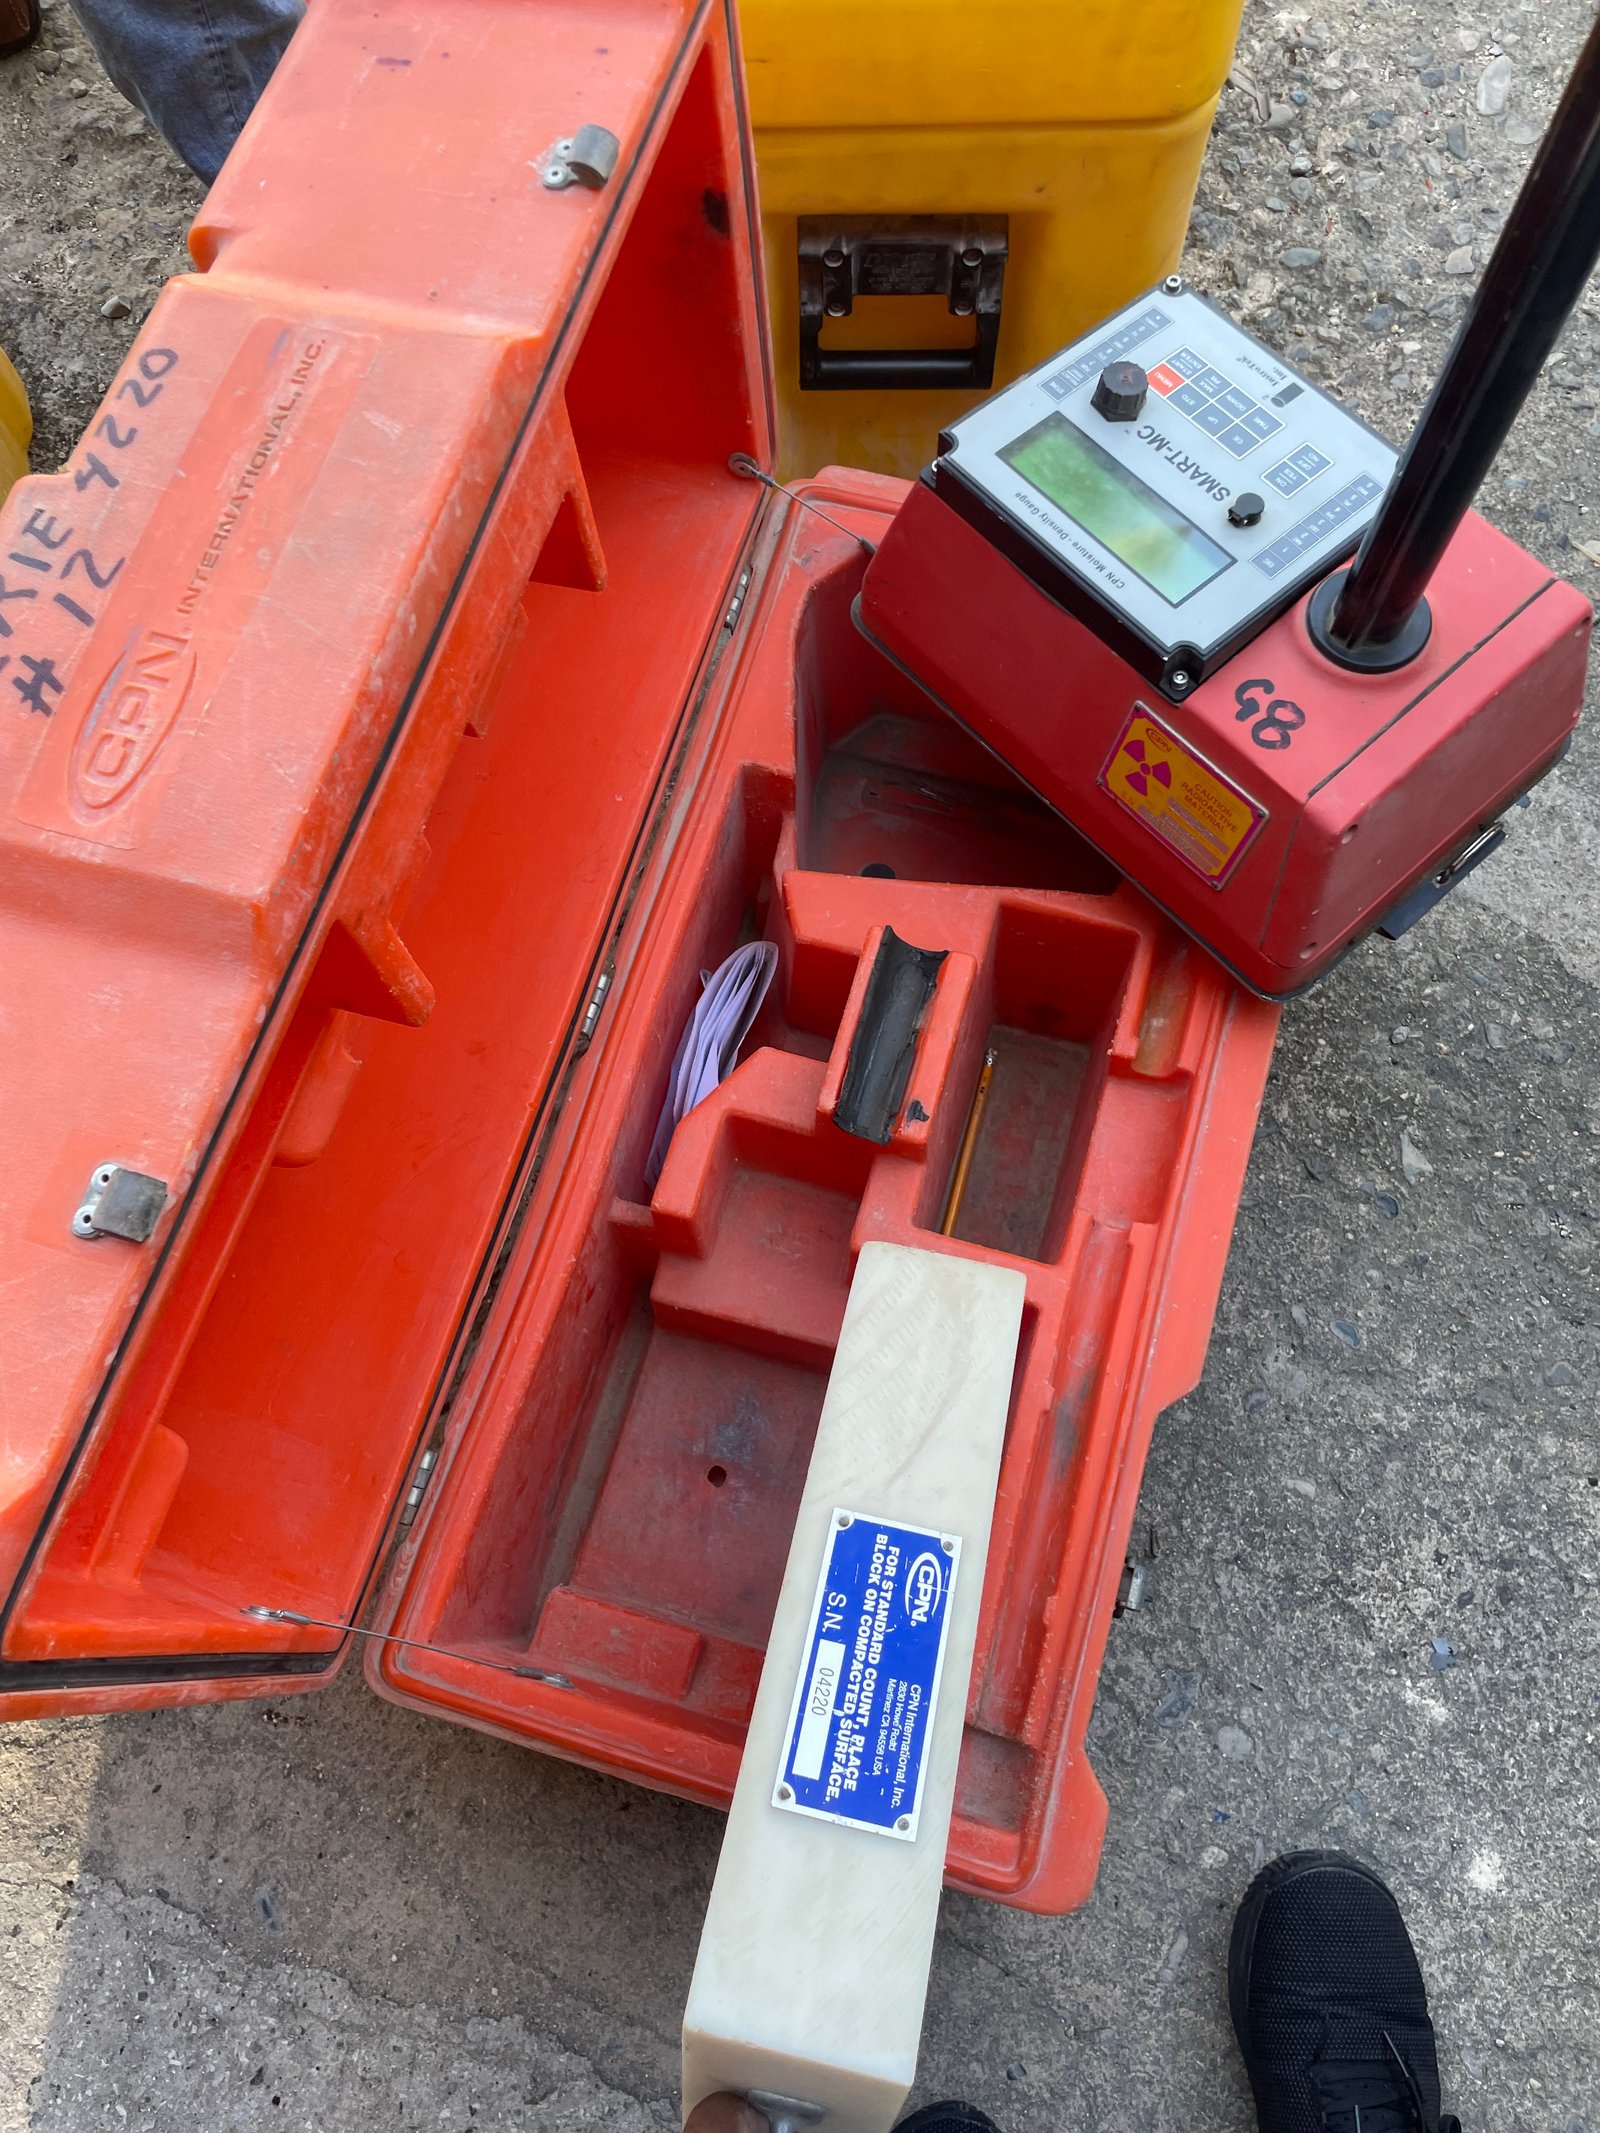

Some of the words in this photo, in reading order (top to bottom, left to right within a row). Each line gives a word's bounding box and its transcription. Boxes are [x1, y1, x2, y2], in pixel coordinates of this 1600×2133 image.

[1170, 357, 1192, 376] START
[1179, 350, 1202, 369] ENTER
[1153, 370, 1173, 388] MENU
[1198, 379, 1214, 393] MAX
[1209, 374, 1221, 385] PR
[1180, 392, 1195, 406] STD
[1224, 393, 1246, 412] DOWN
[1206, 414, 1218, 425] UP
[1252, 415, 1269, 430] TIME
[1232, 434, 1243, 445] CE
[1135, 422, 1231, 503] SMART-MC
[1296, 458, 1312, 471] OFF
[1307, 451, 1319, 462] NO
[1274, 476, 1287, 487] ON
[1283, 467, 1297, 480] YES
[1013, 490, 1041, 516] Gauge
[1037, 511, 1070, 540] Density
[85, 630, 190, 787] CPN
[176, 391, 302, 616] INTERNATIONAL,
[291, 338, 327, 387] INC.
[1070, 540, 1107, 573] Moisture
[1104, 571, 1125, 589] CPN
[1148, 730, 1172, 753] CPN
[1180, 781, 1237, 833] RADIOACTIVE
[1193, 782, 1233, 818] CAUTION
[1182, 793, 1226, 833] MATERIAL
[867, 1533, 888, 1585] BLOCK
[883, 1545, 900, 1577] FOR
[821, 1590, 847, 1634] S.N.
[862, 1587, 877, 1612] ON
[867, 1579, 894, 1664] STANDARD
[841, 1613, 873, 1714] COMPACTED
[810, 1666, 834, 1716] 04220
[852, 1666, 877, 1730] COUNT,
[882, 1677, 897, 1713] Martinez
[896, 1680, 907, 1702] 2830
[906, 1683, 922, 1711] CPN
[880, 1713, 890, 1727] CA
[891, 1702, 904, 1728] Howe
[887, 1727, 900, 1751] Road
[892, 1710, 918, 1785] International,
[824, 1717, 853, 1802] SURFACE.
[842, 1733, 865, 1791] PLACE
[871, 1755, 883, 1776] USA
[890, 1786, 904, 1809] Inc.
